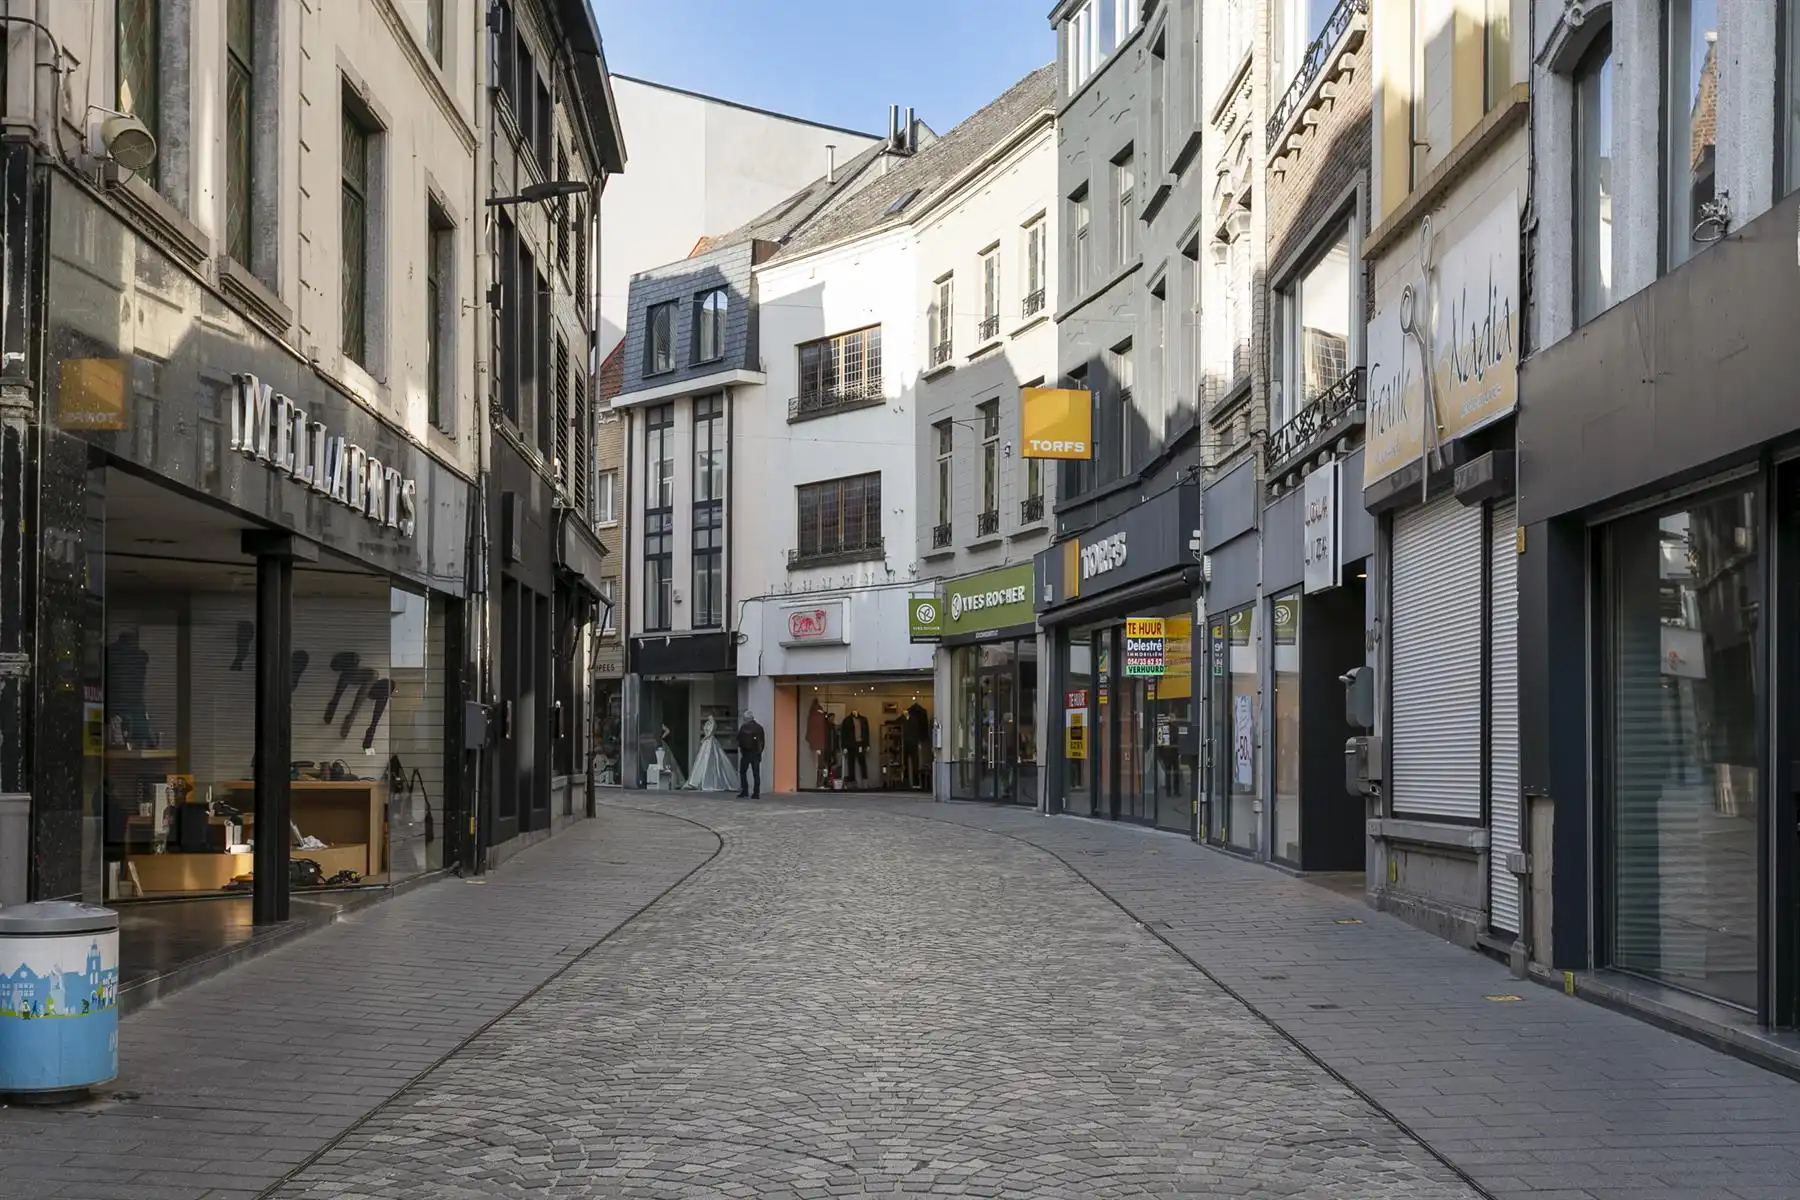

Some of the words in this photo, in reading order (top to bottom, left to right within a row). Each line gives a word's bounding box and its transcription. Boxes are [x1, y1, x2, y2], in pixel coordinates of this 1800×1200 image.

[1029, 439, 1086, 453] TORFS
[1081, 531, 1127, 580] TORFS
[962, 593, 985, 612] YVES
[985, 585, 1026, 608] ROCHER
[1128, 622, 1136, 635] TE
[1139, 622, 1161, 635] HUUR
[1127, 639, 1162, 651] Delestré
